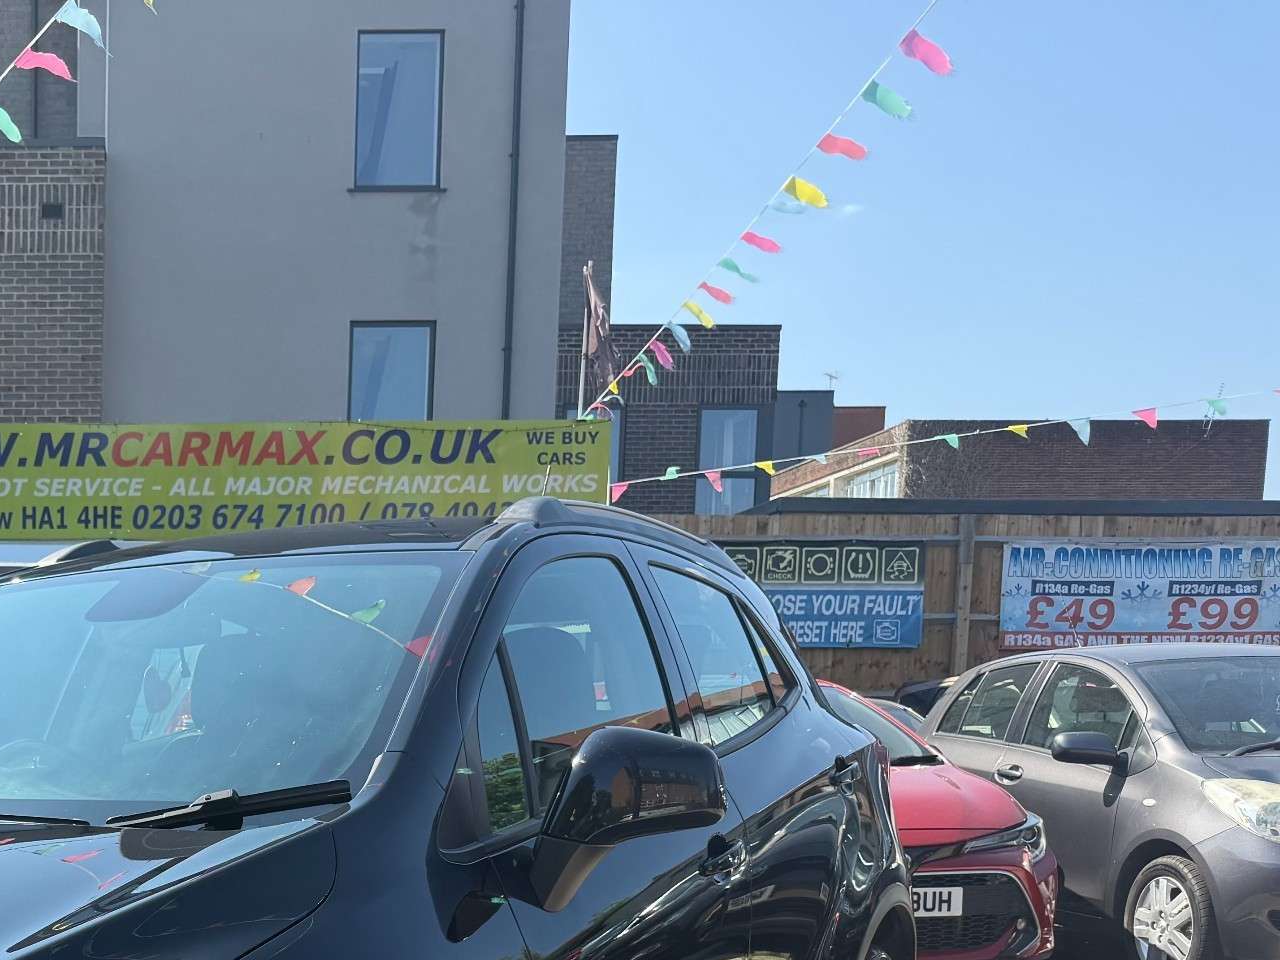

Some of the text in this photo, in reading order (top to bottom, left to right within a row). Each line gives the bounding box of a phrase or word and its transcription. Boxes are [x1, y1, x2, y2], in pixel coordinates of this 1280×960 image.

[526, 431, 599, 445] WE BUY
[537, 452, 586, 465] CARS
[34, 477, 144, 497] SERVICE
[168, 477, 215, 496] ALL
[224, 476, 313, 496] MAJOR
[321, 475, 491, 495] MECHANICAL
[502, 473, 598, 494] WORKS
[22, 505, 68, 530] HA1
[77, 505, 123, 530] 4HE
[132, 504, 203, 530] 0203
[212, 503, 264, 530] 674
[276, 502, 346, 528] 7100
[1008, 546, 1213, 579] AIR-CONDITIONING
[768, 572, 793, 580] CHECK
[1035, 582, 1111, 594] R134a Re-Gas
[1172, 583, 1258, 595] R1234yf Re-Gas
[769, 594, 917, 616] OSE YOUR FAULT
[1025, 595, 1115, 630] £49
[1167, 596, 1259, 630] £99
[831, 620, 865, 643] HERE
[1004, 633, 1052, 647] R134a
[1054, 633, 1085, 647] GAS
